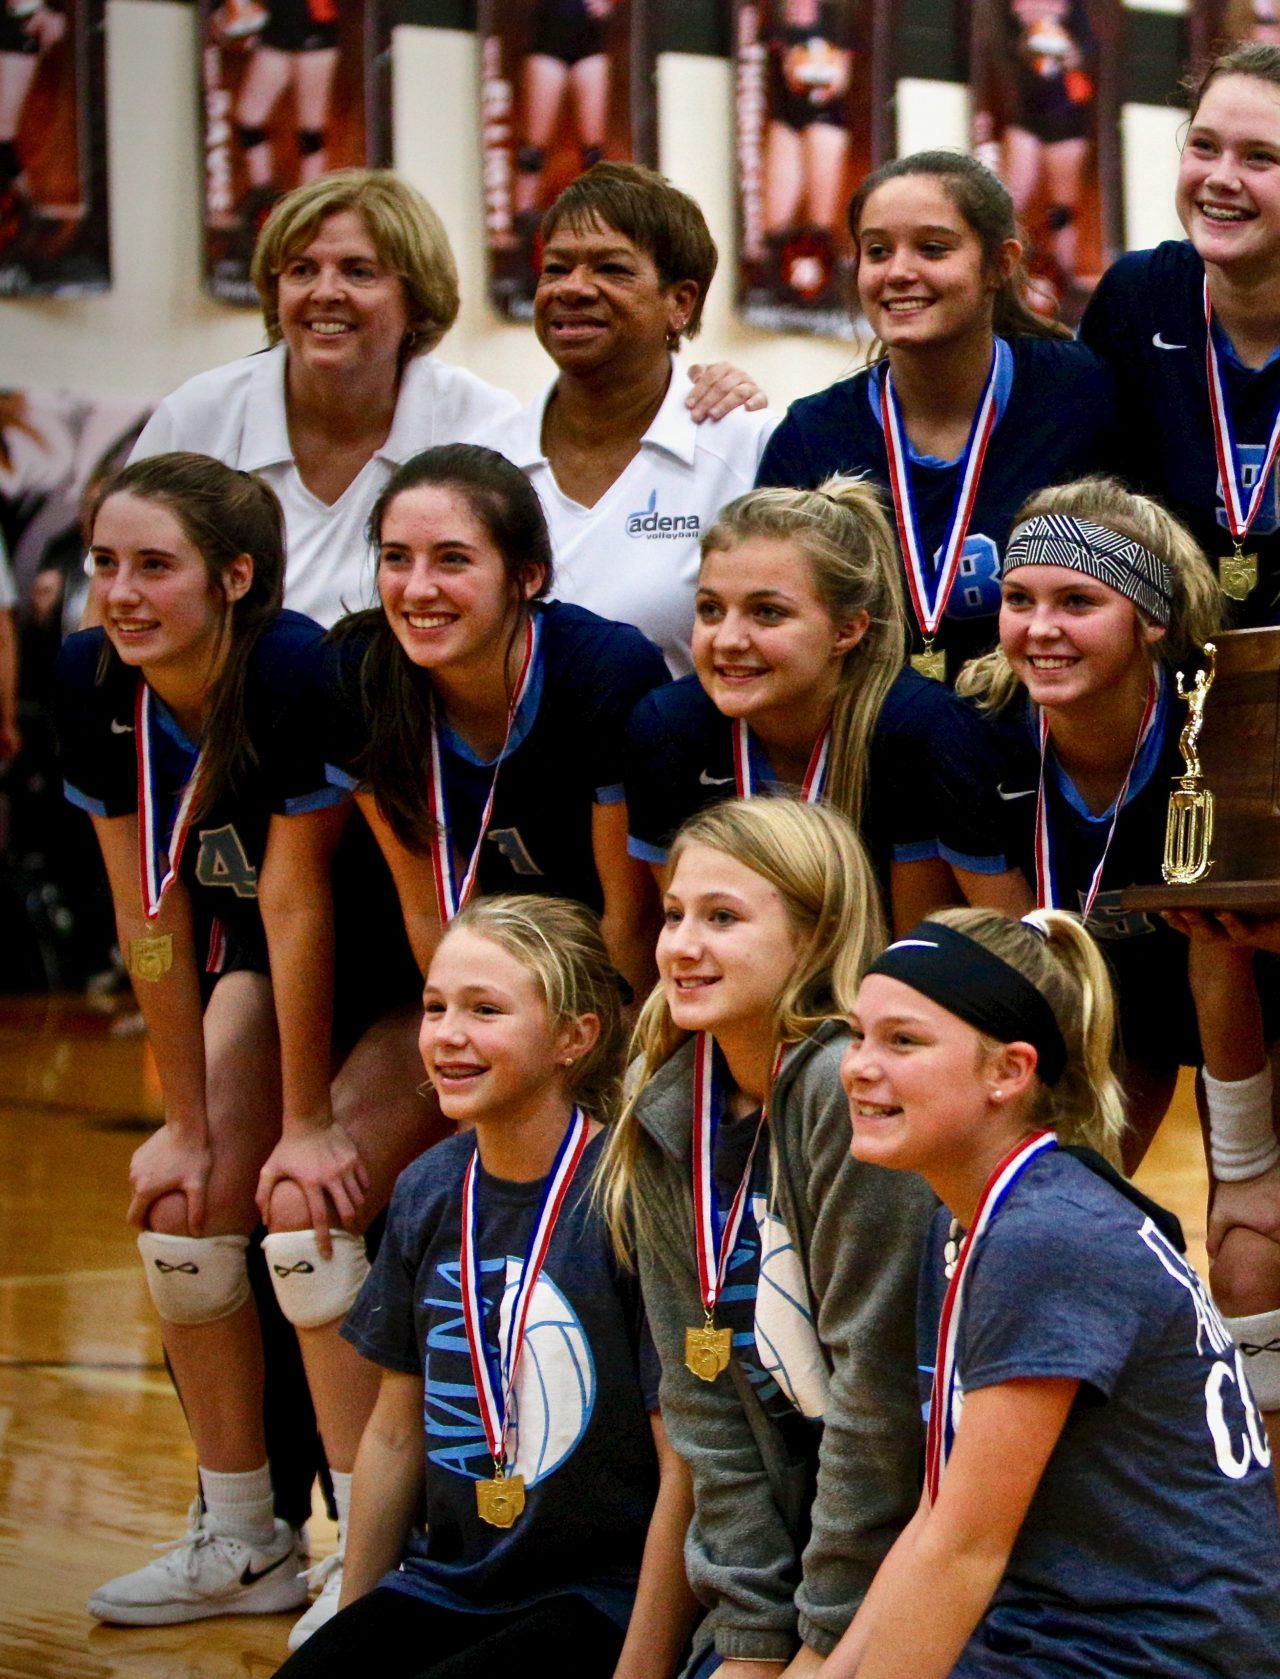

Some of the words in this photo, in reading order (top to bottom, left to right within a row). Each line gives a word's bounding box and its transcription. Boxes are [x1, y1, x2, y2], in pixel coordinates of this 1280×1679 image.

[629, 512, 700, 533] adena
[646, 530, 699, 540] volleyball
[195, 823, 258, 898] 4
